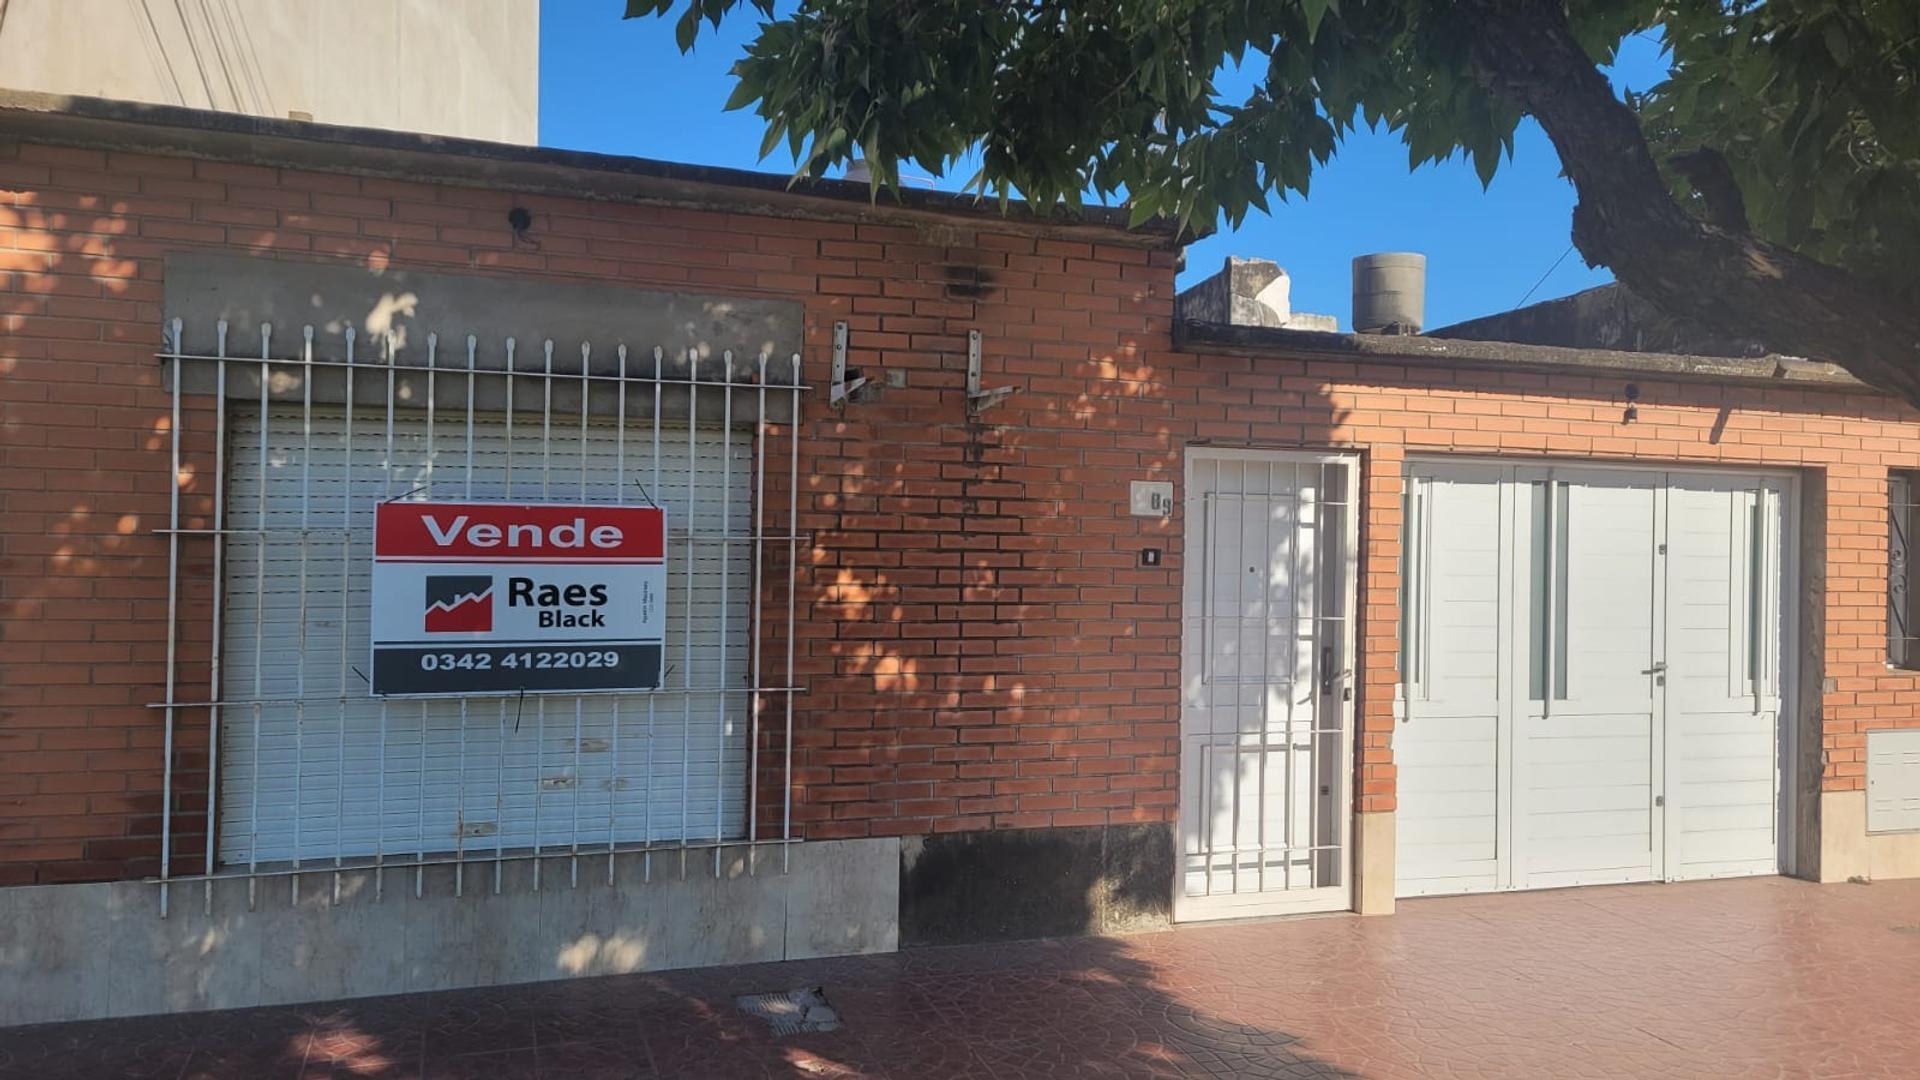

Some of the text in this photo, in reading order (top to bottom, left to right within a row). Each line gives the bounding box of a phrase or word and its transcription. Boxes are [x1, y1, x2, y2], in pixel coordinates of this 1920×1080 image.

[421, 515, 623, 548] Vende
[508, 577, 608, 607] Raes
[538, 610, 605, 628] Black
[421, 651, 619, 670] 0342 4122029
